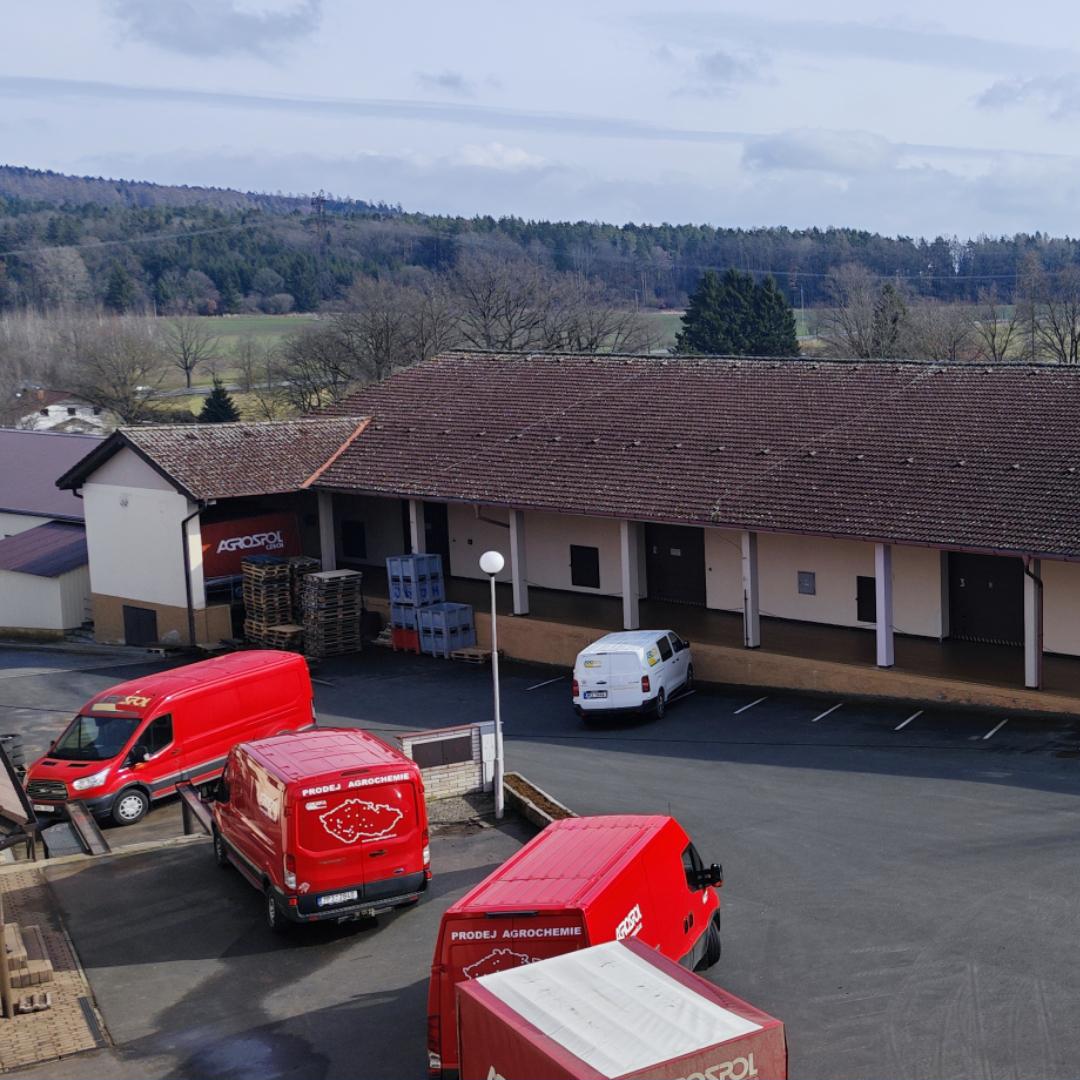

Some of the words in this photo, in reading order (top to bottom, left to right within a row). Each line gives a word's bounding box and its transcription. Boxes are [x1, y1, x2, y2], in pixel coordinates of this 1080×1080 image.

[216, 531, 283, 554] AGROSPOL
[302, 784, 341, 797] PRODEJ
[348, 773, 409, 788] AGROCHEMIE
[452, 931, 497, 940] PRODEJ
[502, 927, 582, 938] AGROCHEMIE
